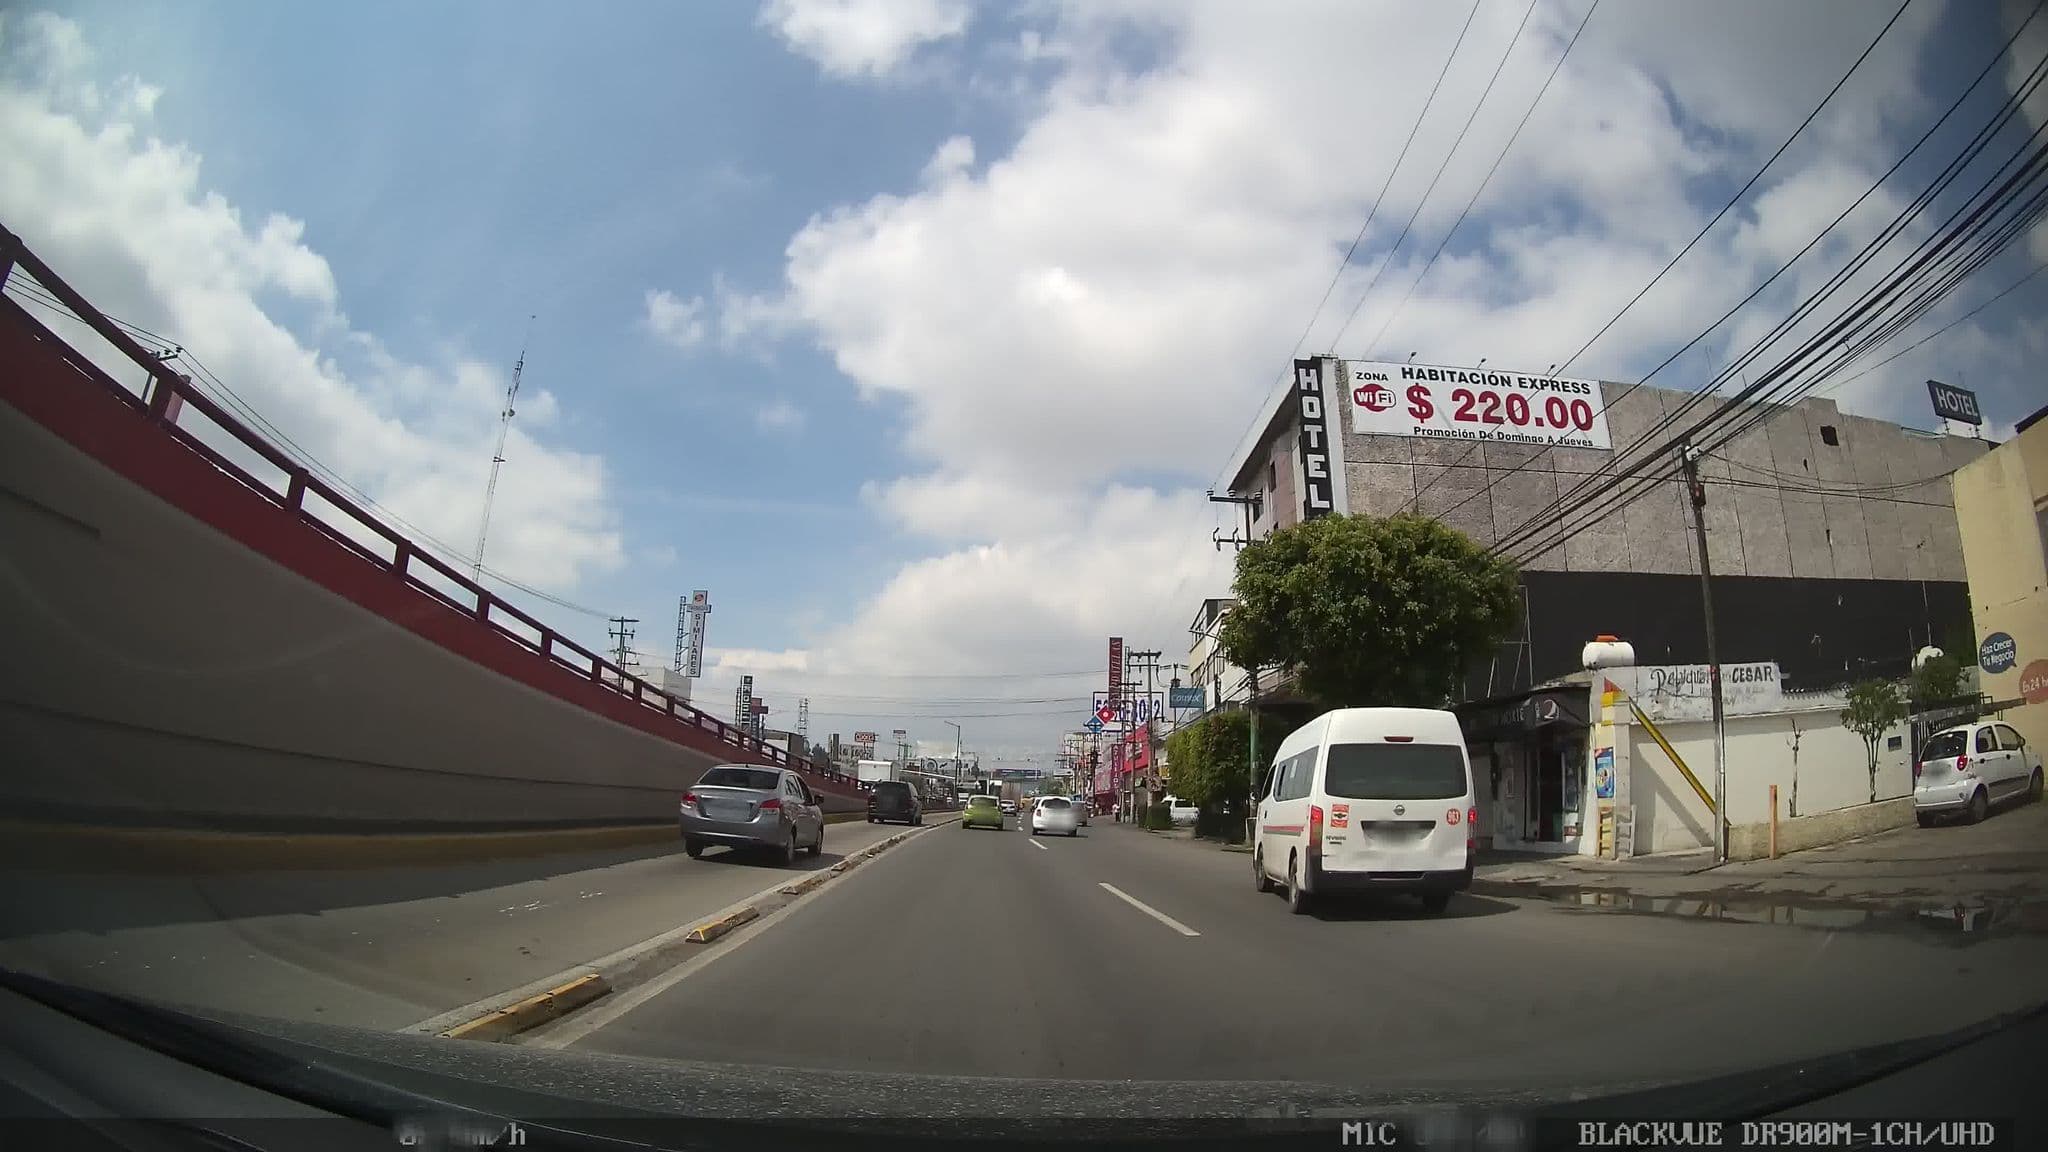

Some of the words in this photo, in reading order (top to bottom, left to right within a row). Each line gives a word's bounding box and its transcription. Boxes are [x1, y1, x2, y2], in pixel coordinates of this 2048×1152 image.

[1356, 371, 1389, 382] ZONA
[1401, 366, 1512, 388] HABITACIÓN
[1518, 376, 1591, 395] EXPRESS
[1406, 383, 1434, 423] $
[1451, 388, 1594, 432] 220.00
[1934, 385, 1978, 418] HOTEL
[1299, 368, 1331, 509] HOTEL
[1413, 425, 1475, 440] Promoción
[1479, 430, 1494, 440] De
[1497, 431, 1544, 444] Domingo
[1547, 435, 1556, 444] A
[1558, 435, 1593, 447] Jueves
[690, 613, 701, 675] SIMILARES
[1732, 665, 1774, 684] CESAR
